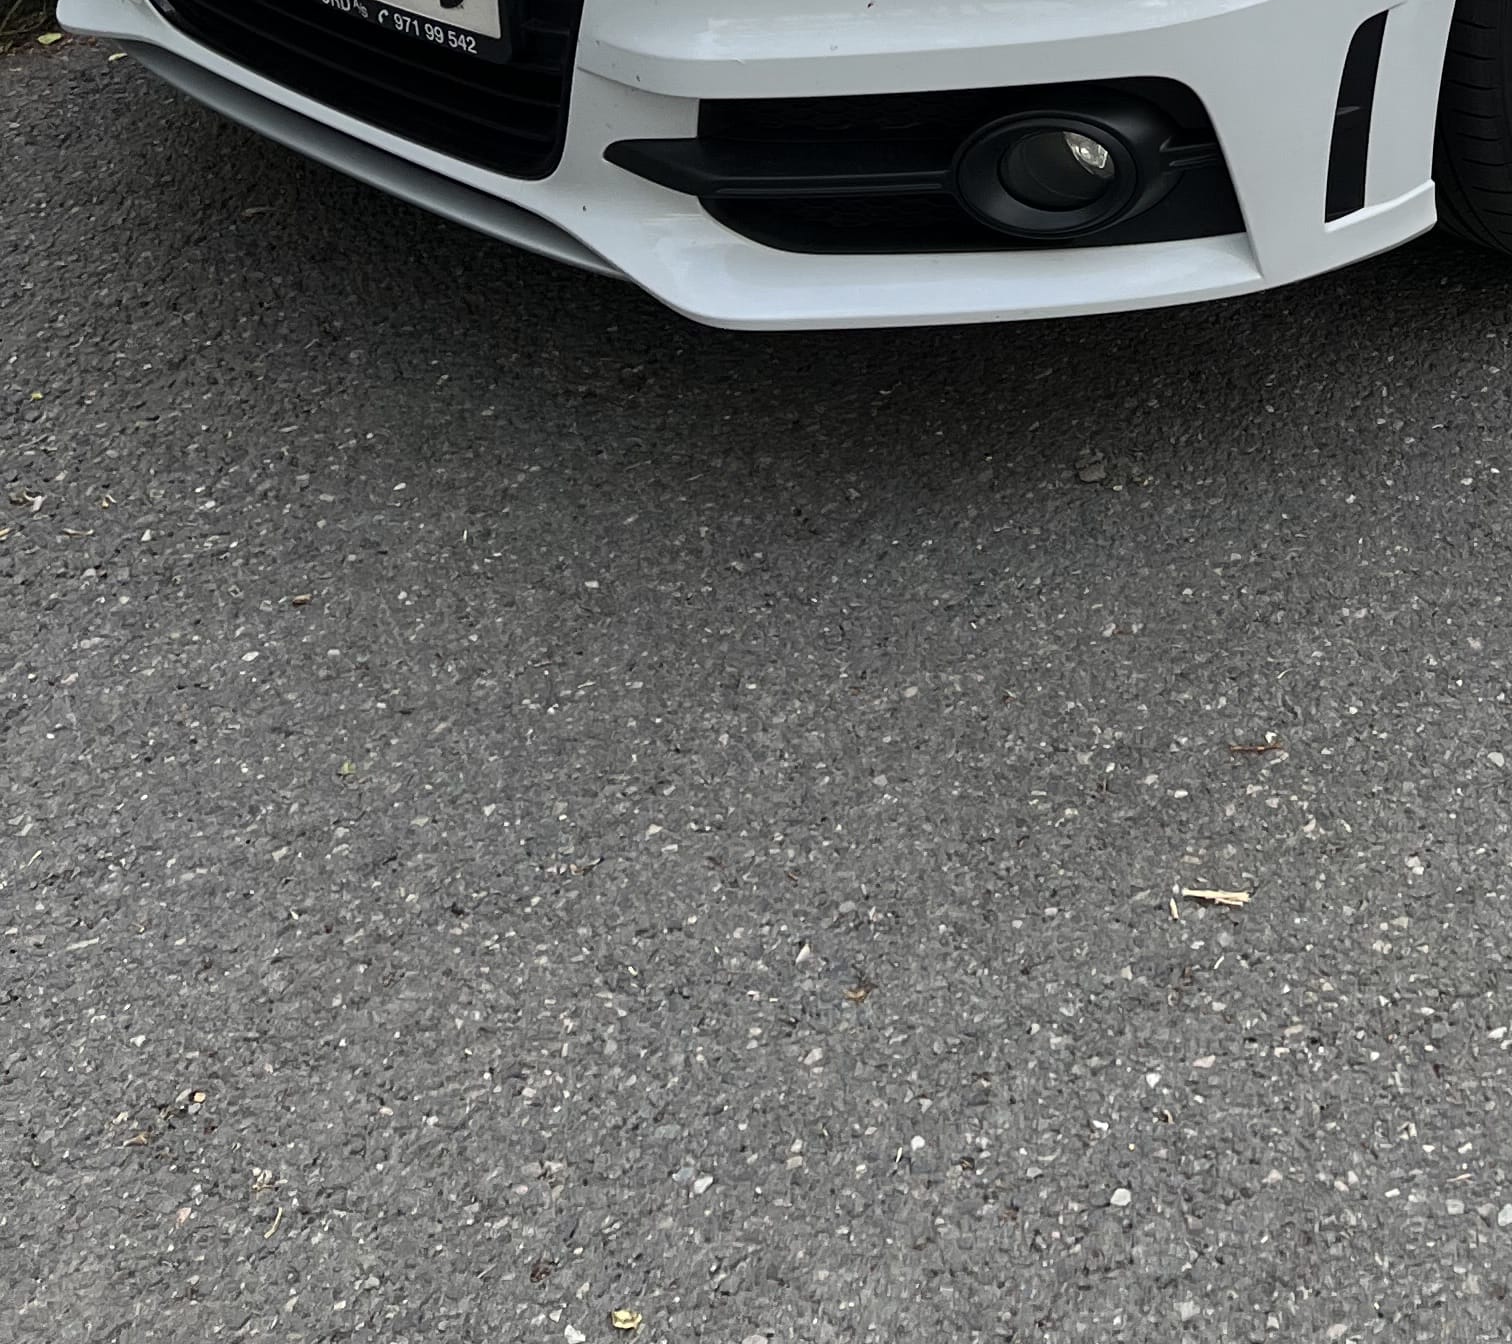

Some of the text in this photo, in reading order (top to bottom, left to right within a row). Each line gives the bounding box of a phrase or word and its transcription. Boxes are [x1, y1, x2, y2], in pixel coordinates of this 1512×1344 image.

[393, 13, 421, 37] 971
[425, 23, 444, 44] 99
[448, 30, 478, 55] 542
